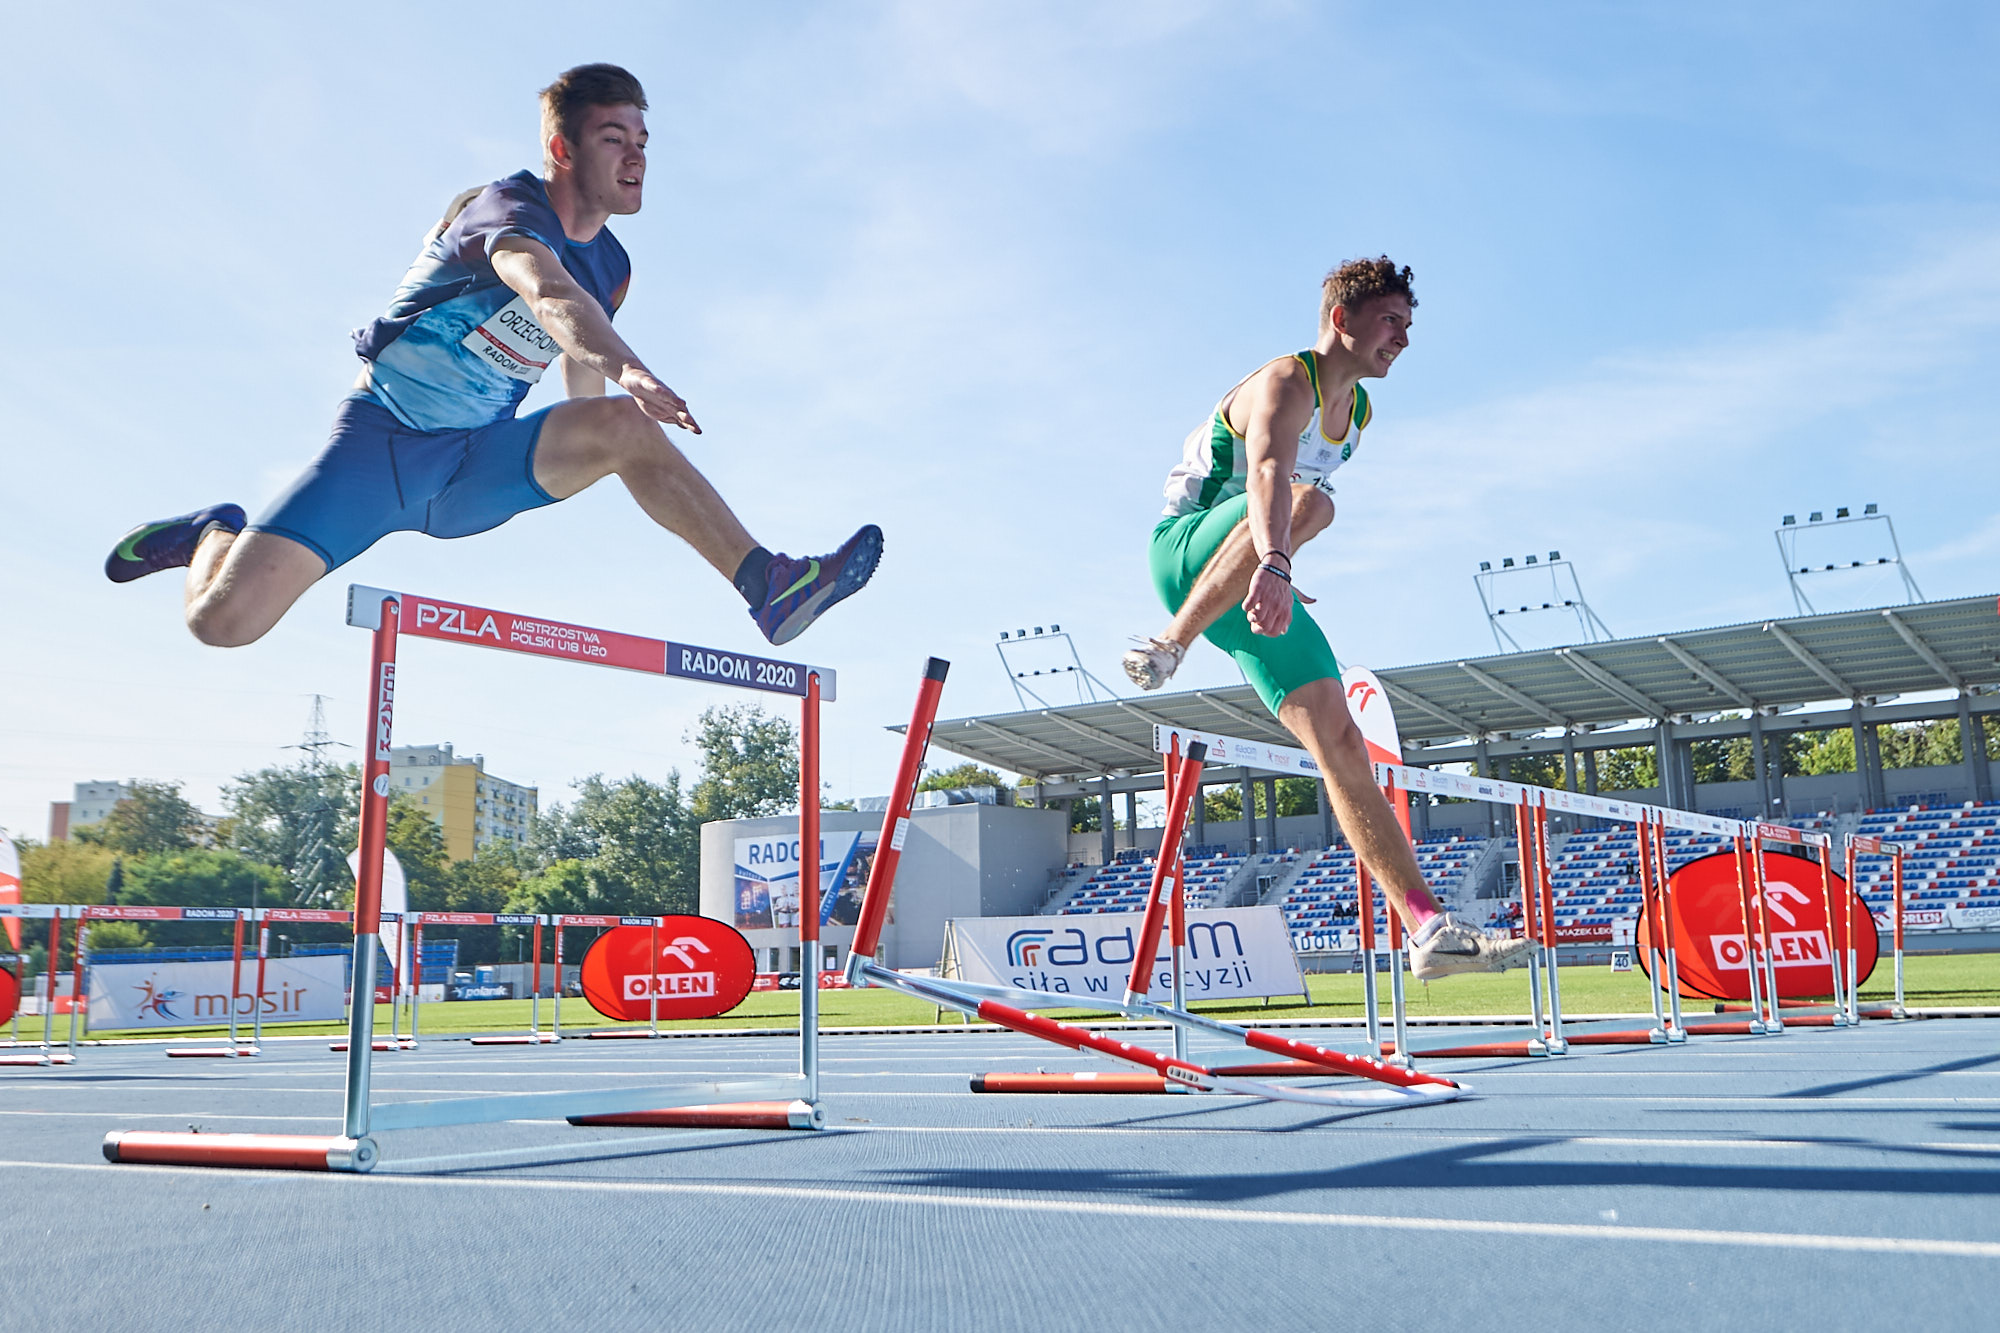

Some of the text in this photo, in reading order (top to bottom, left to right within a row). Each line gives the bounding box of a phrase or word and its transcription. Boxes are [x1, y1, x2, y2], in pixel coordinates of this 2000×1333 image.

[483, 345, 519, 372] RADOM
[416, 603, 501, 640] PZLA
[511, 619, 600, 644] MISTRZOSTWA
[510, 632, 607, 657] POLSKI U18 U20
[681, 649, 796, 688] RADOM 2020
[749, 839, 824, 865] RADO
[1293, 934, 1342, 950] DOM
[1615, 956, 1629, 967] 40
[465, 986, 508, 997] polanik
[629, 976, 708, 996] ORLEN
[1084, 975, 1108, 992] w
[194, 981, 307, 1016] mosir
